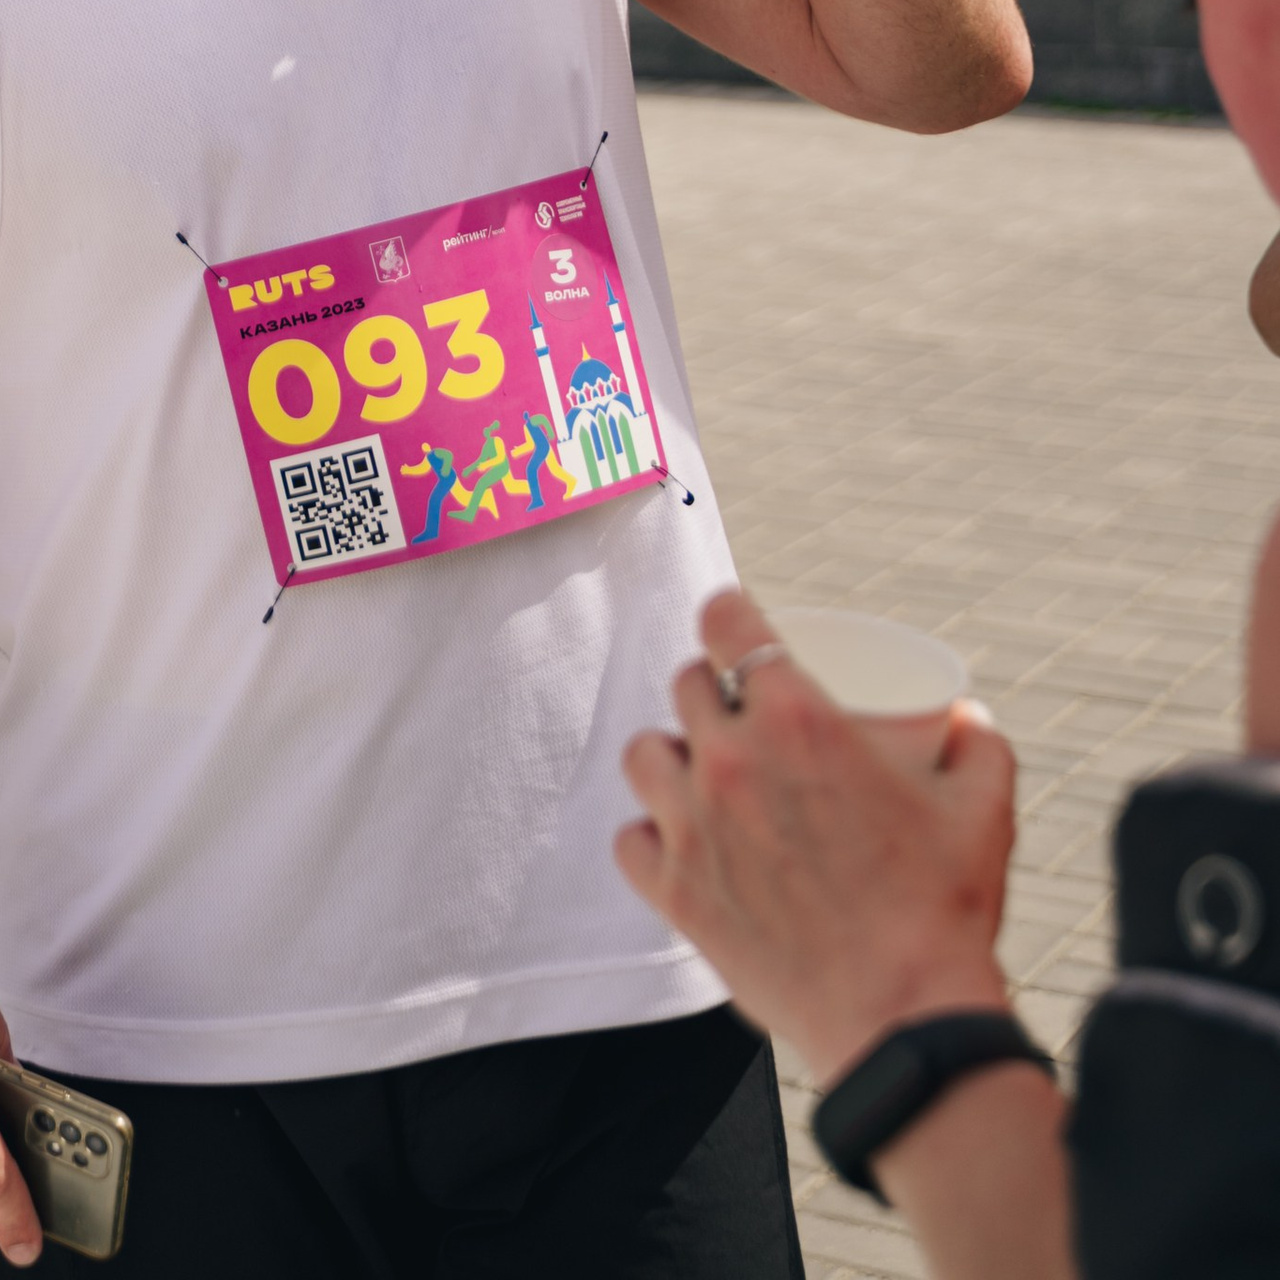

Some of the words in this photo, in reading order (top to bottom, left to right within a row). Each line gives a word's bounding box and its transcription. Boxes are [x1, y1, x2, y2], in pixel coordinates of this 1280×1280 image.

[548, 248, 577, 284] 3
[228, 264, 335, 312] RUTS
[544, 286, 590, 302] ВОЛНА
[239, 311, 318, 339] КАЗАНЬ
[321, 297, 366, 319] 2023
[247, 288, 506, 445] 093
